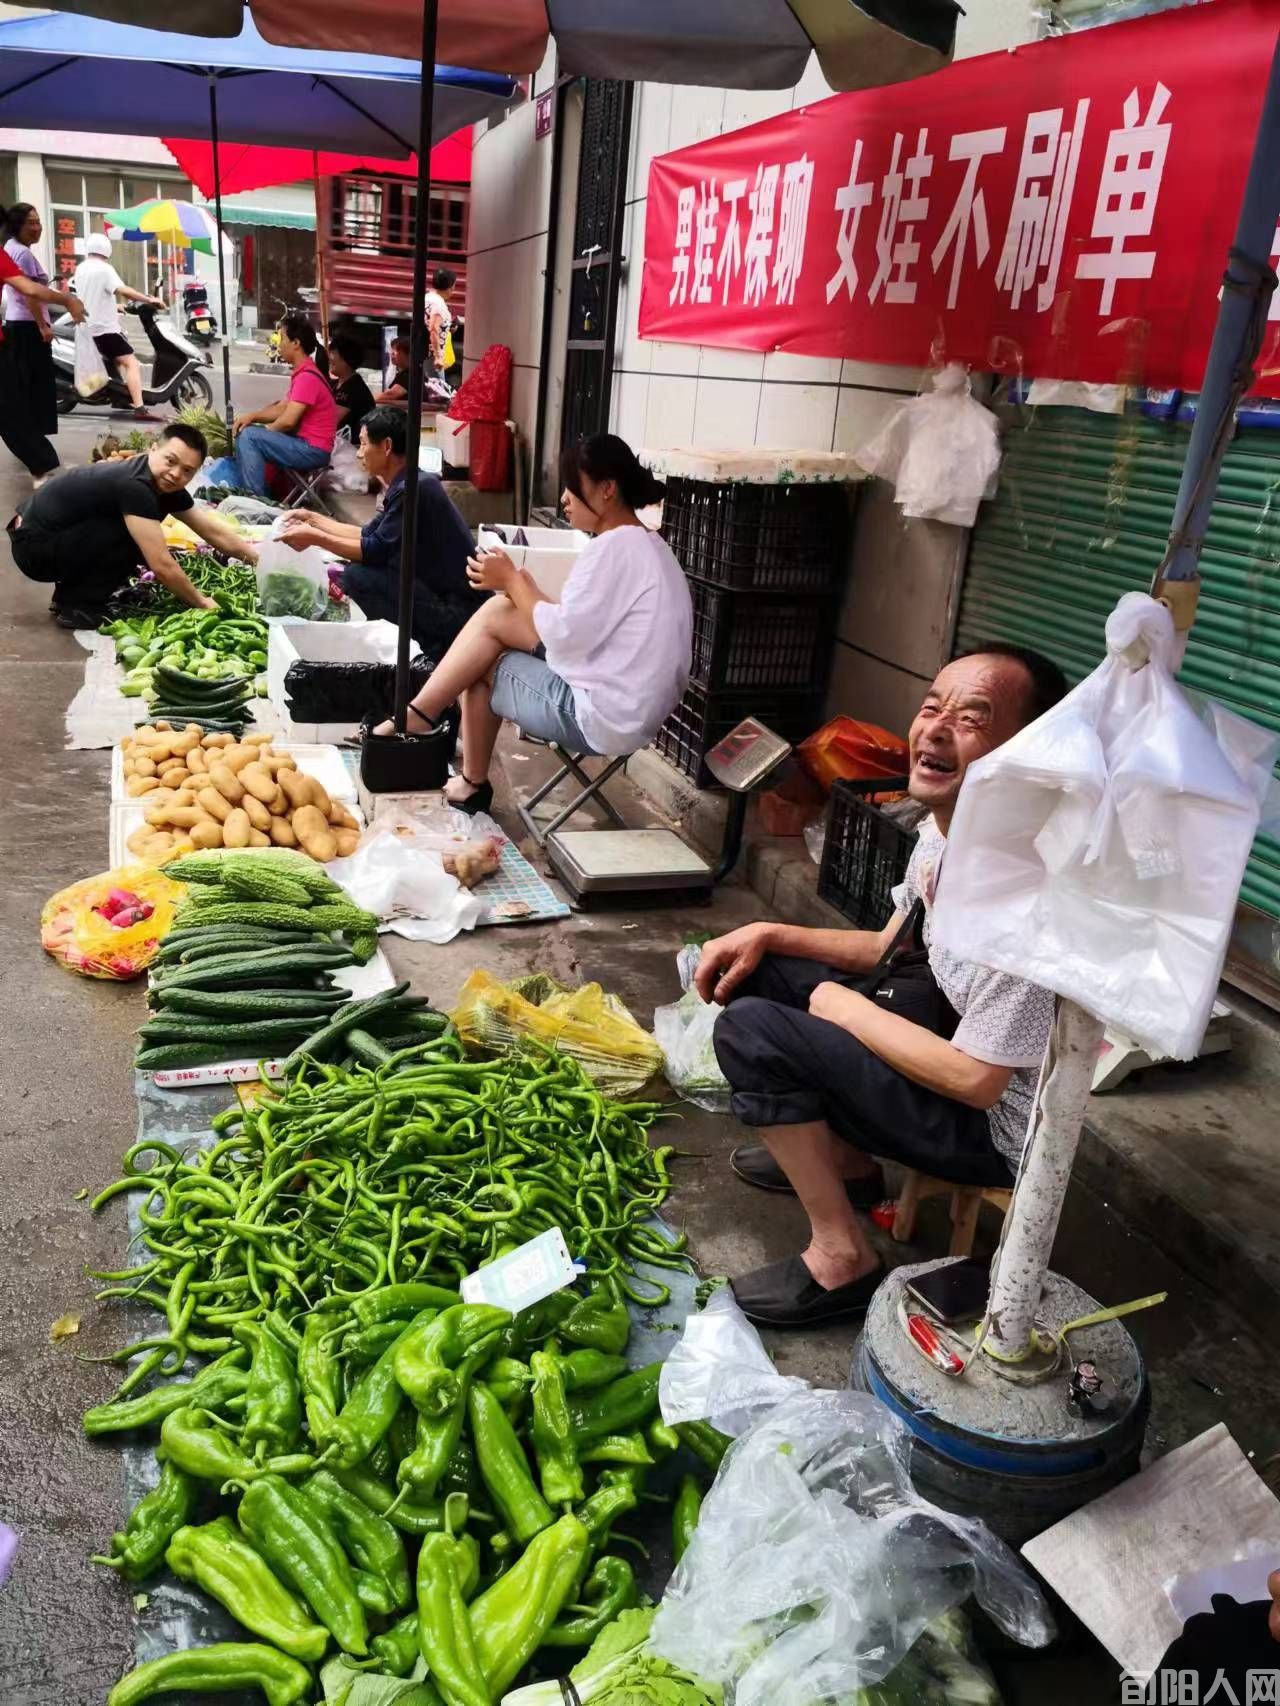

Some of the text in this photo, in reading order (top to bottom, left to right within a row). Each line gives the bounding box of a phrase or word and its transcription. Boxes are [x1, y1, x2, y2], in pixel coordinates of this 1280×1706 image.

[669, 152, 815, 307] 男娃不裸聊
[826, 81, 1172, 316] 女娃不刷单
